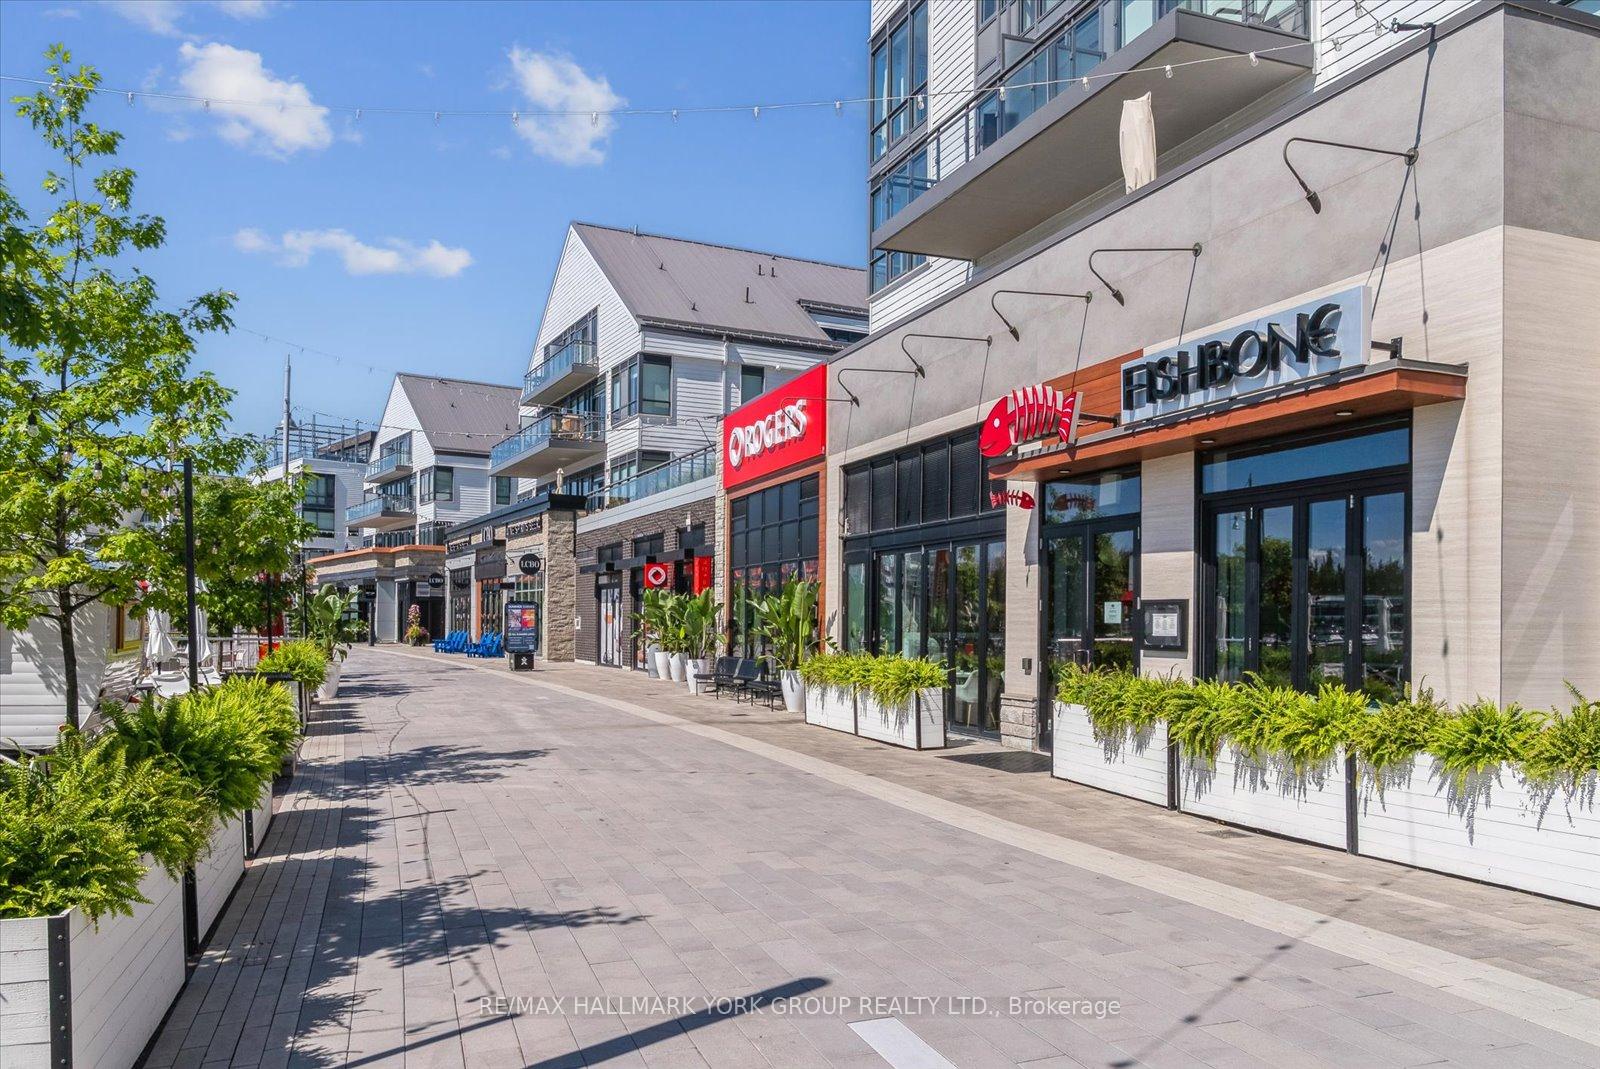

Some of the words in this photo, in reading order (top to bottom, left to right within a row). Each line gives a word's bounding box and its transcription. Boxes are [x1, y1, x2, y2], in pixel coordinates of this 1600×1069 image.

[1123, 303, 1341, 411] FISHBONE
[744, 399, 808, 458] ROGERS
[521, 561, 540, 569] LCBO
